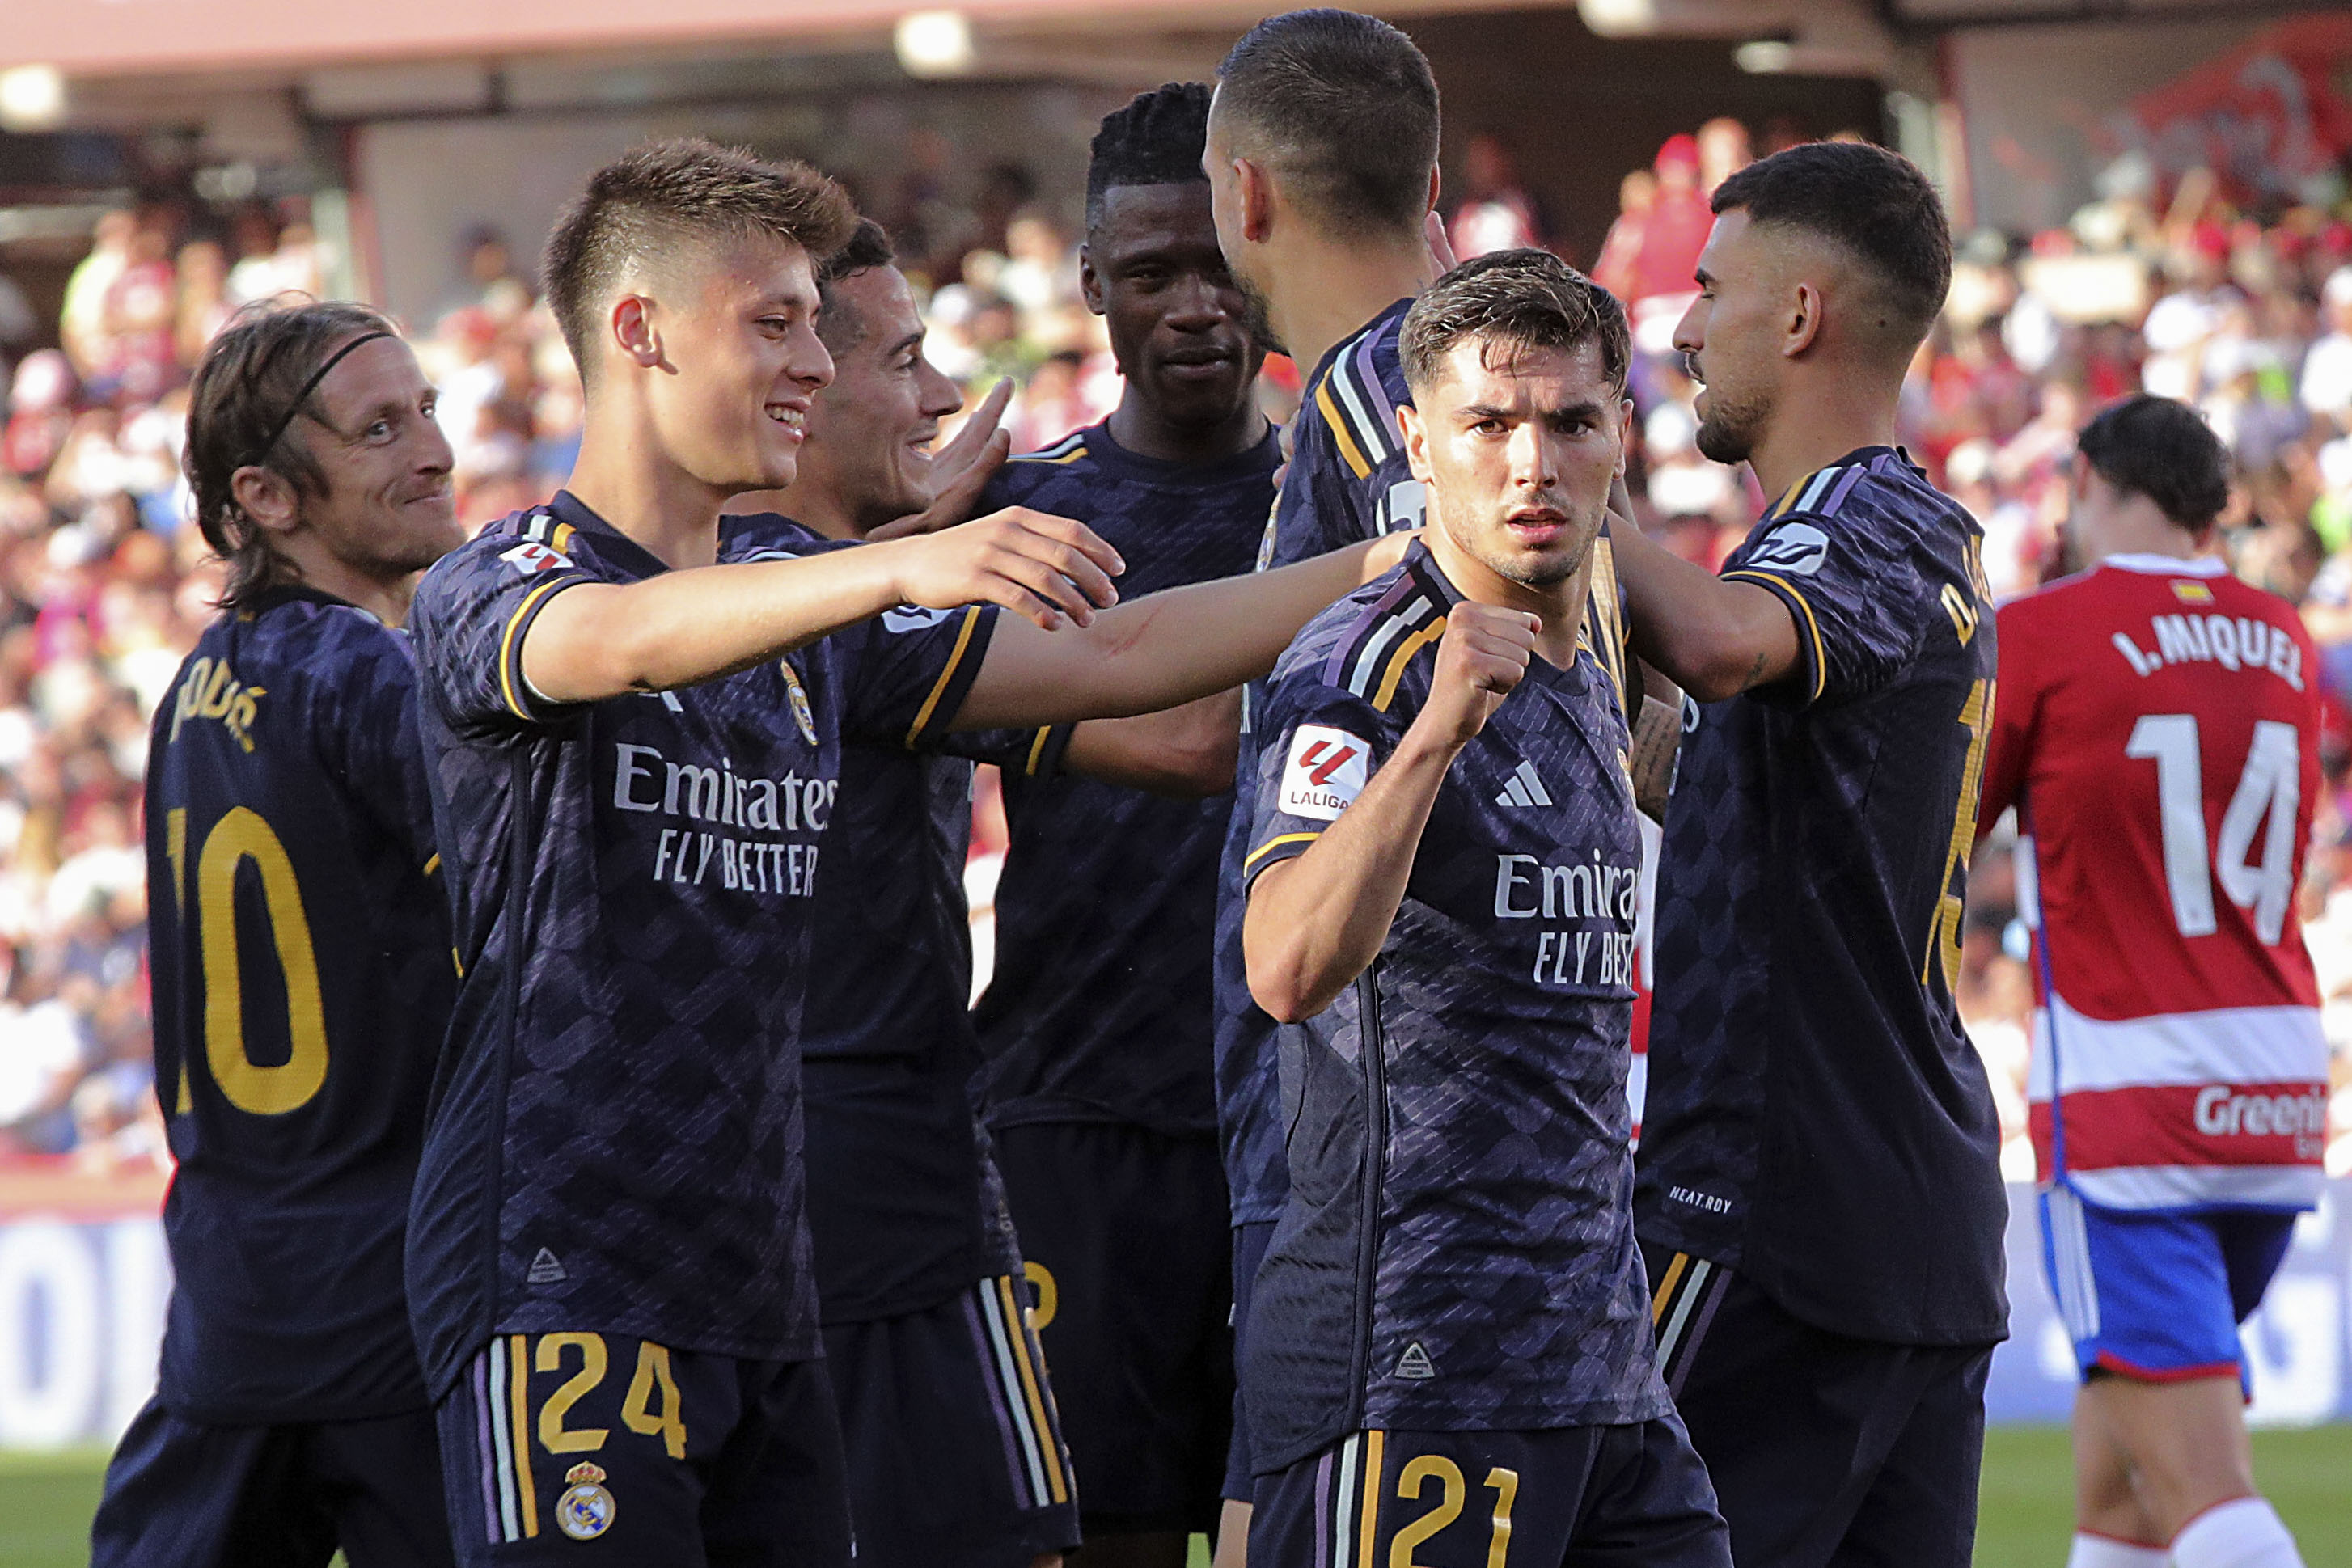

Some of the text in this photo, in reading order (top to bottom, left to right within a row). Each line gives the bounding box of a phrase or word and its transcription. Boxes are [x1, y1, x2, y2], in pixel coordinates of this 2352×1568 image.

[1290, 791, 1349, 810] LALIGA
[2124, 713, 2301, 947] 14
[654, 828, 819, 897] FLY BETTER
[1495, 848, 1641, 920] Emira
[1533, 932, 1592, 984] FLY
[535, 1331, 687, 1460] 24
[1389, 1454, 1519, 1568] 21
